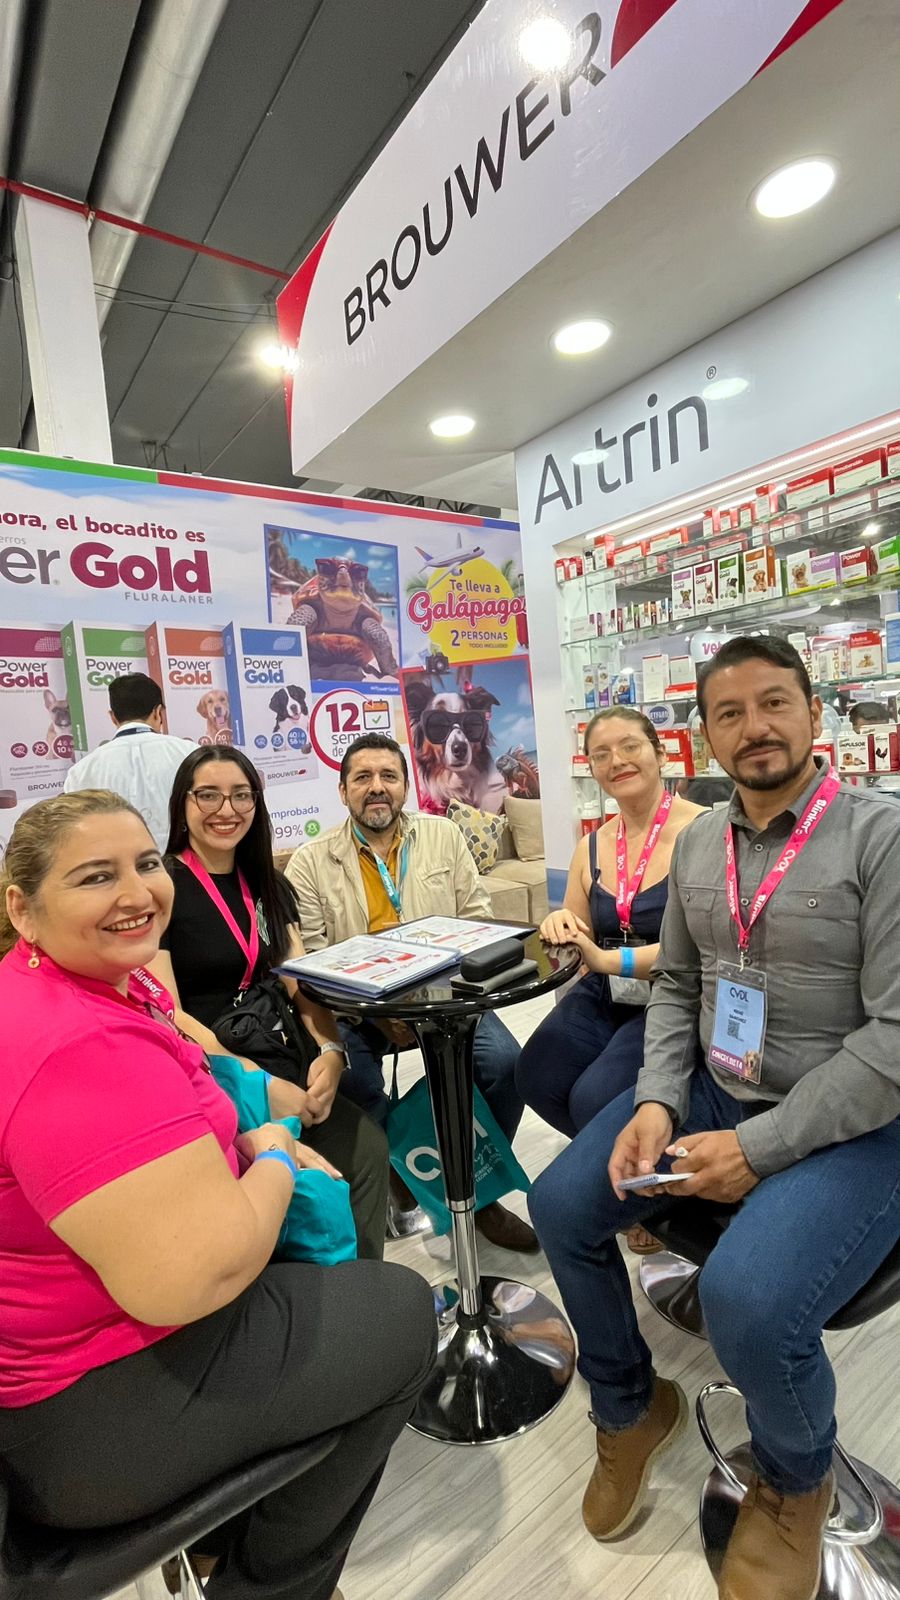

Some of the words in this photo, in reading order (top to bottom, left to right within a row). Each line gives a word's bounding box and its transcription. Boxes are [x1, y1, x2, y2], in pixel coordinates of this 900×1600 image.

[343, 12, 607, 345] BROUWER
[56, 515, 78, 531] el
[85, 516, 178, 540] bocadito
[185, 530, 206, 542] es
[70, 542, 211, 594] Gold
[449, 579, 463, 591] Te
[465, 579, 491, 593] lleva
[125, 592, 213, 605] FLURALANER
[451, 630, 460, 647] 2
[461, 631, 509, 640] PERSONAS
[0, 660, 47, 672] Power
[86, 659, 132, 672] Power
[168, 658, 211, 670] Power
[243, 657, 283, 669] Power
[0, 672, 49, 687] Gold
[169, 670, 212, 685] Gold
[244, 669, 285, 684] Gold
[326, 702, 361, 733] 12
[332, 744, 344, 757] de
[267, 770, 299, 780] BROUWER
[275, 824, 303, 838] 99%
